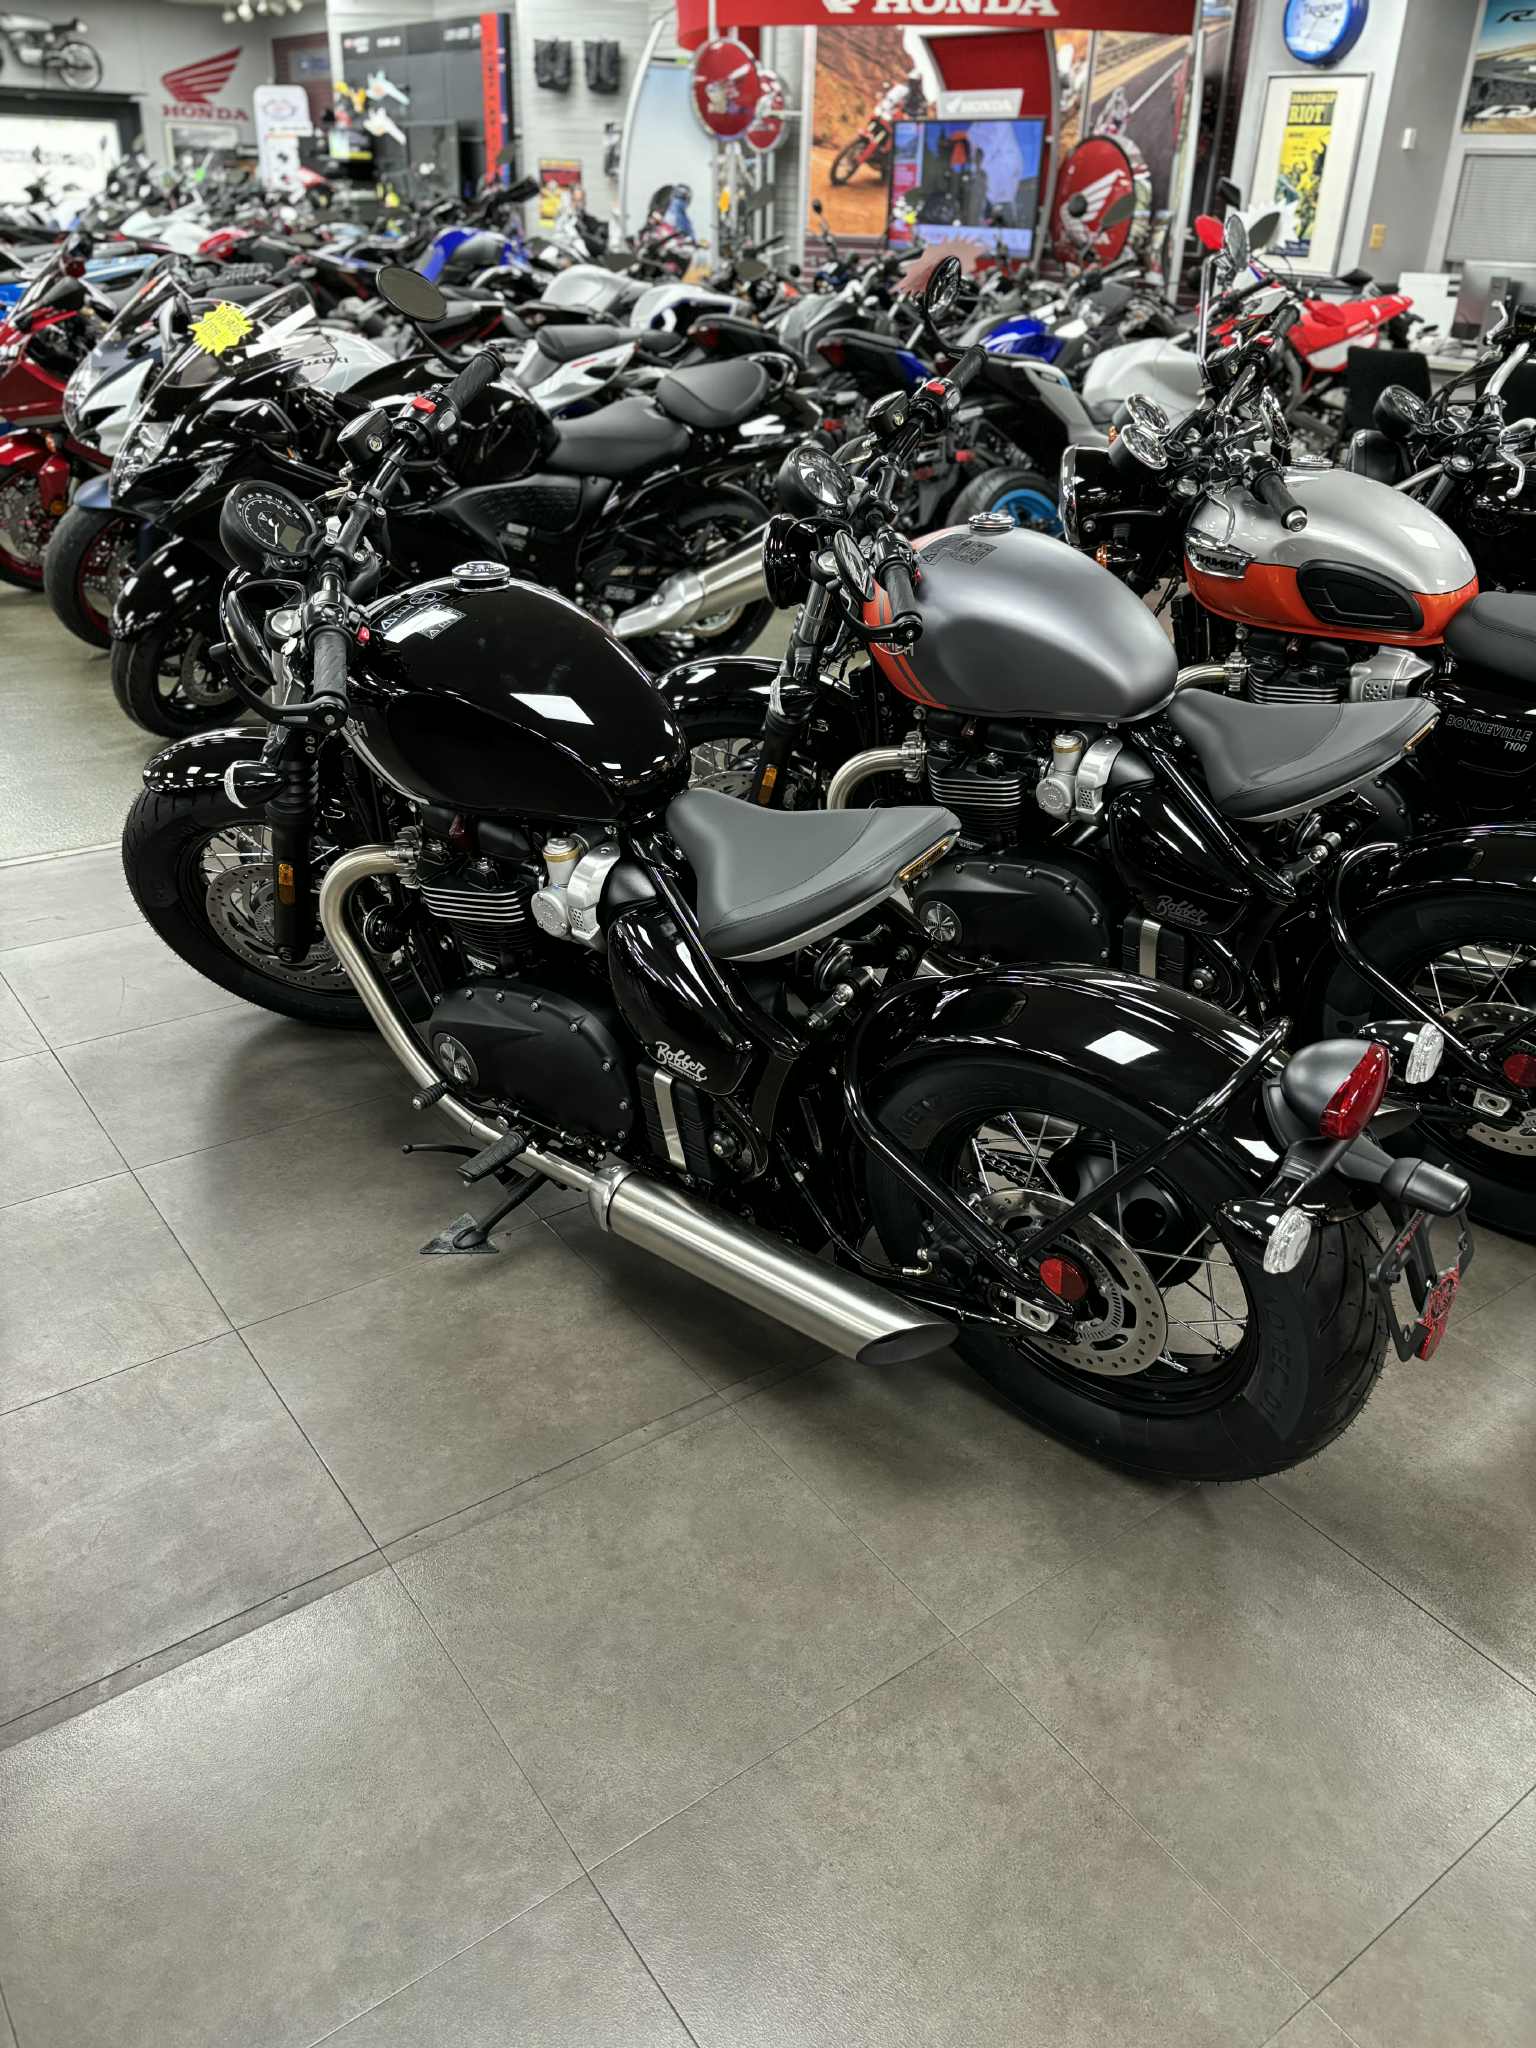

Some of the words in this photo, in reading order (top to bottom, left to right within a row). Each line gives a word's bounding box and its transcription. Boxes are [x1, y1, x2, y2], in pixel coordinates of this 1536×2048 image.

[870, 0, 1060, 16] HONDA
[162, 104, 249, 121] HONDA
[1288, 102, 1326, 122] RIOT
[1445, 714, 1533, 743] BONNEVILLE
[1504, 740, 1527, 753] T100
[1156, 895, 1210, 925] Bobber
[655, 1039, 708, 1082] Bobber
